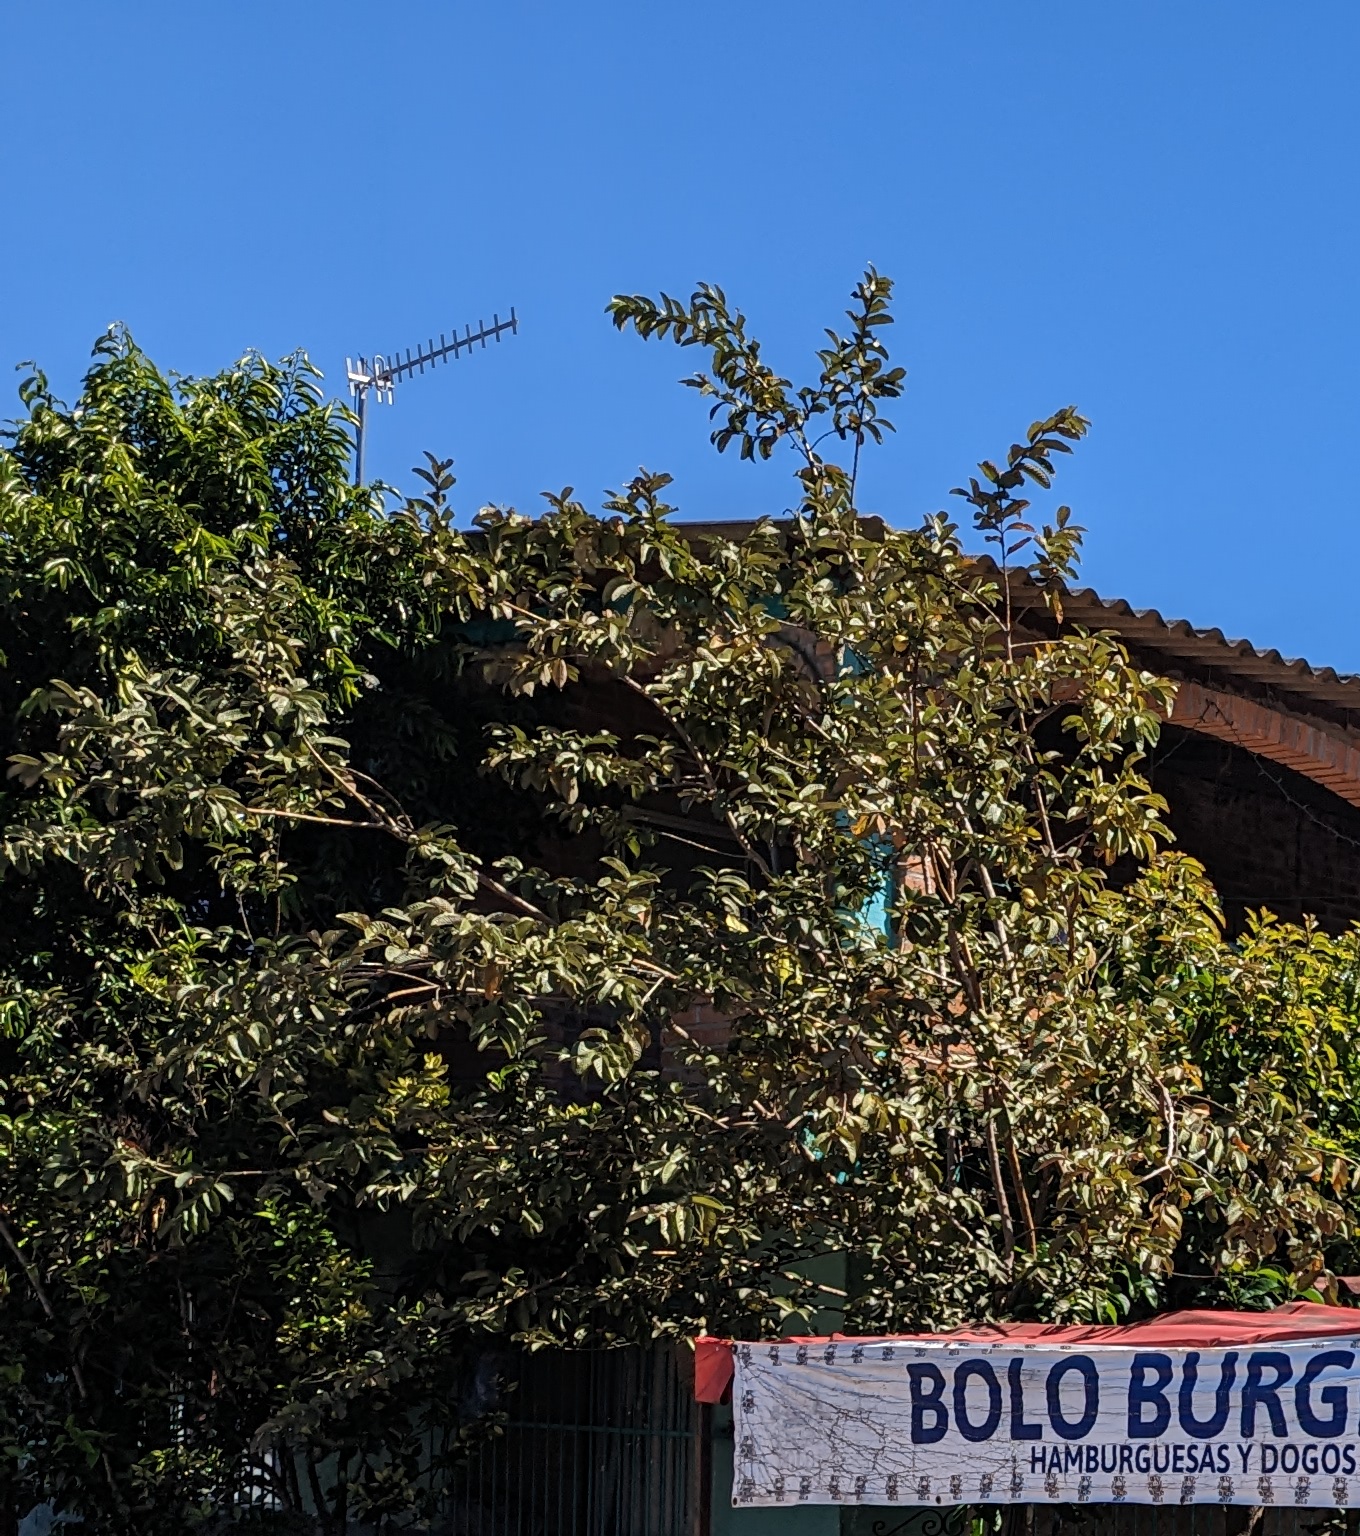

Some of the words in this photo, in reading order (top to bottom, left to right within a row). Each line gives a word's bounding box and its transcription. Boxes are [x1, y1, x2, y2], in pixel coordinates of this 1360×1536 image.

[906, 1354, 1099, 1444] BOLO
[1030, 1444, 1229, 1474] HAMBURGUESAS
[1237, 1444, 1254, 1473] Y
[1261, 1443, 1356, 1475] DOGOS
